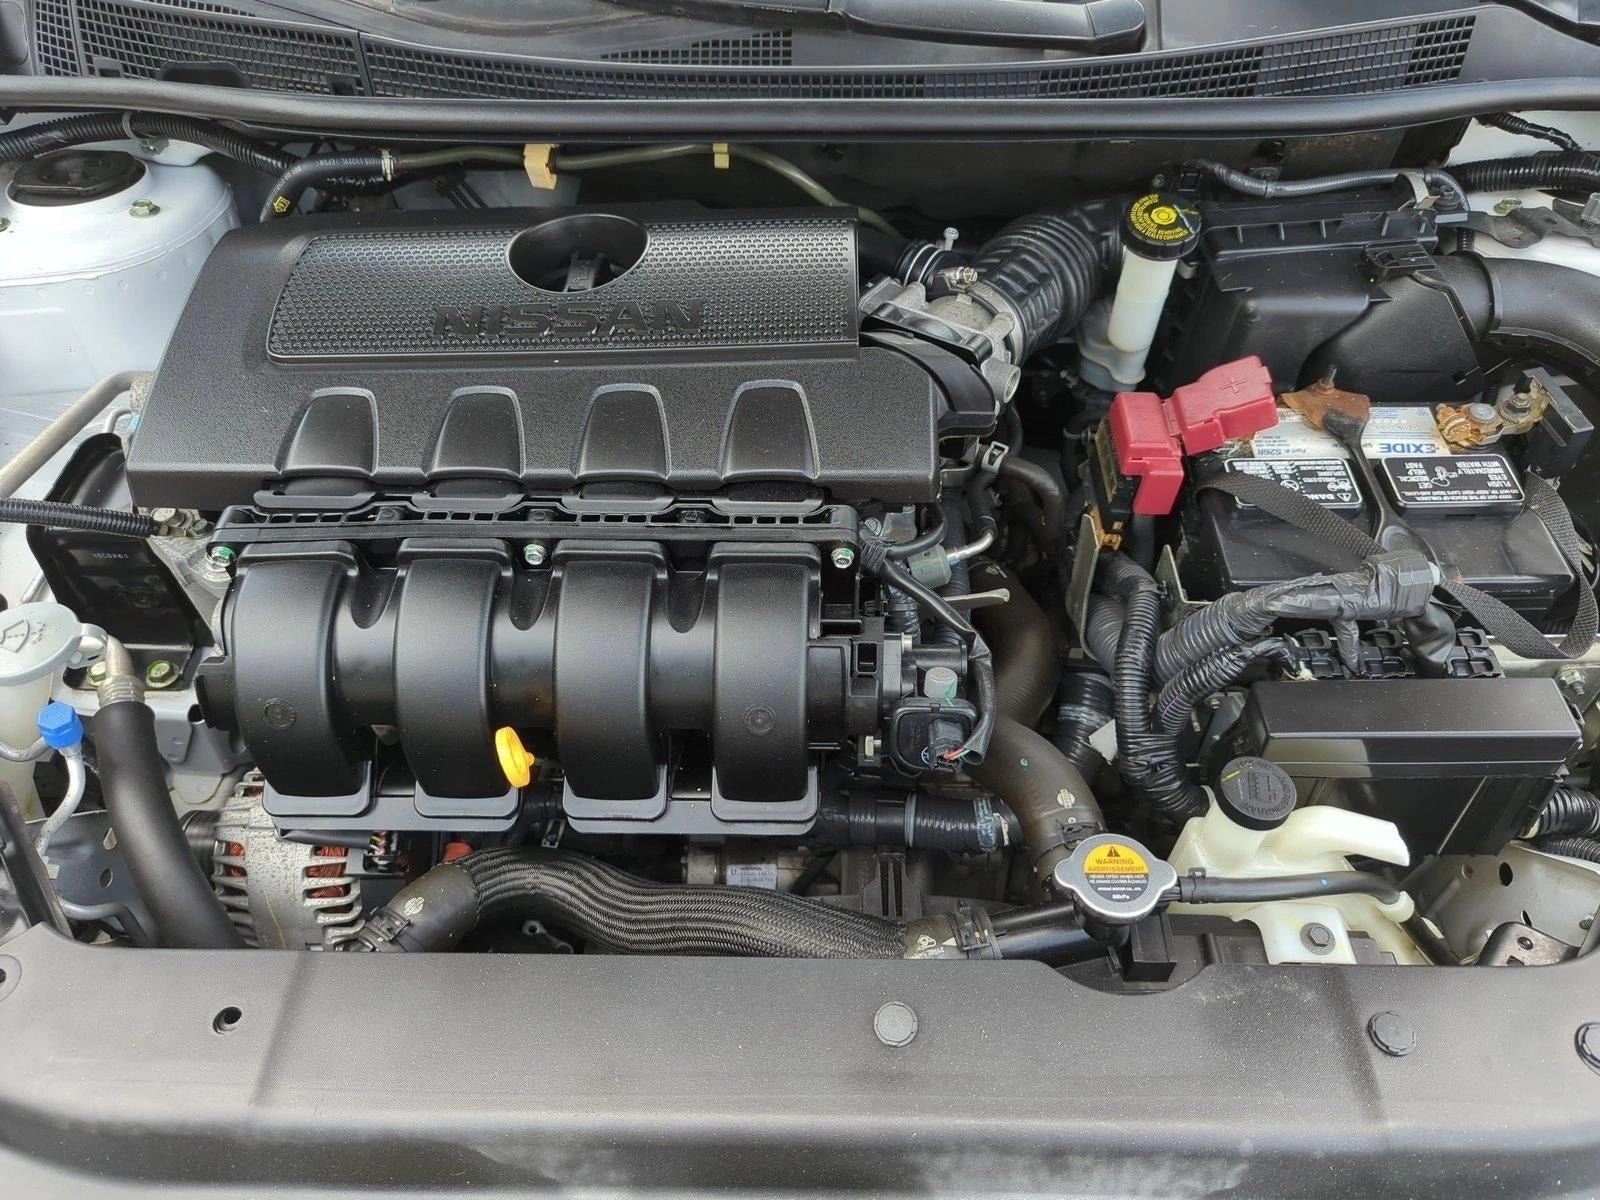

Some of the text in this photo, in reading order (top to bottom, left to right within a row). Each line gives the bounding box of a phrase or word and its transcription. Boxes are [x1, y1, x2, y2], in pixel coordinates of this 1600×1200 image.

[432, 299, 703, 337] NISSAN
[1379, 443, 1436, 454] EXIDE
[1457, 467, 1505, 475] IMMEDIATELY
[1487, 480, 1511, 488] FLUSH
